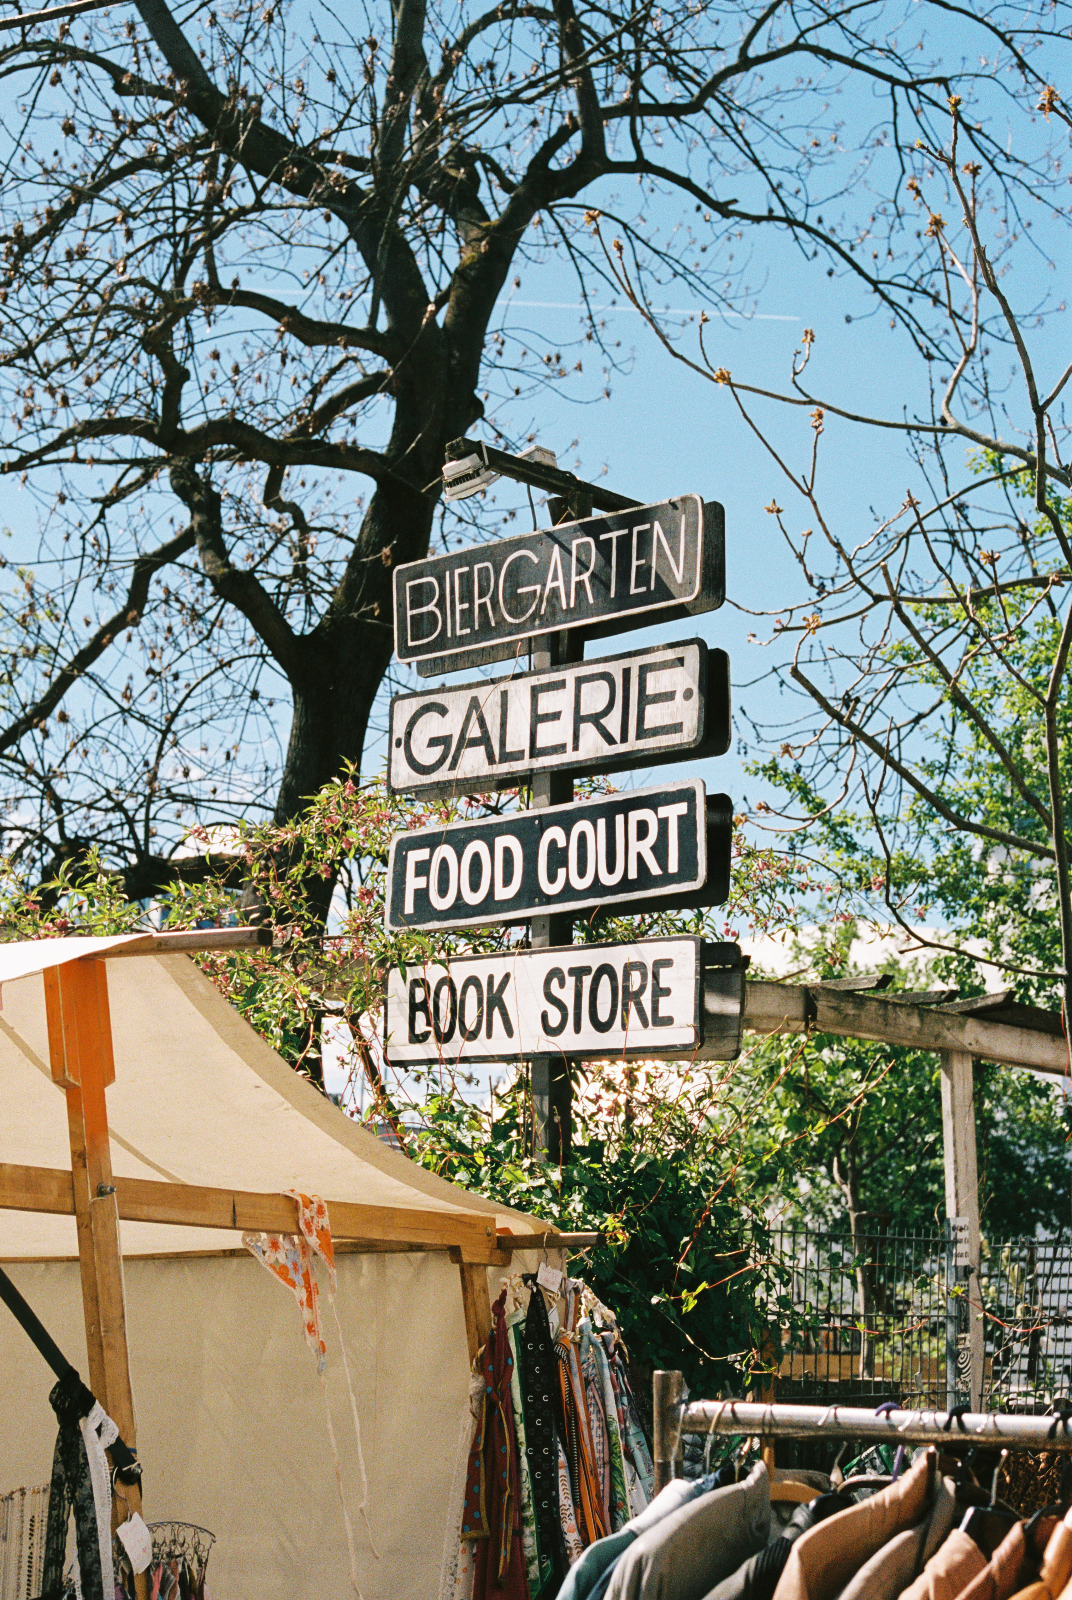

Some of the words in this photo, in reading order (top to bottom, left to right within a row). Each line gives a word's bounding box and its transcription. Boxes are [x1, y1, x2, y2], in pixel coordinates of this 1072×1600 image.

[405, 514, 686, 647] BIERGARTEN
[403, 656, 685, 776] GALERIE
[404, 834, 524, 915] FOOD
[537, 802, 688, 896] COURT
[407, 971, 515, 1045] BOOK
[540, 957, 675, 1038] STORE
